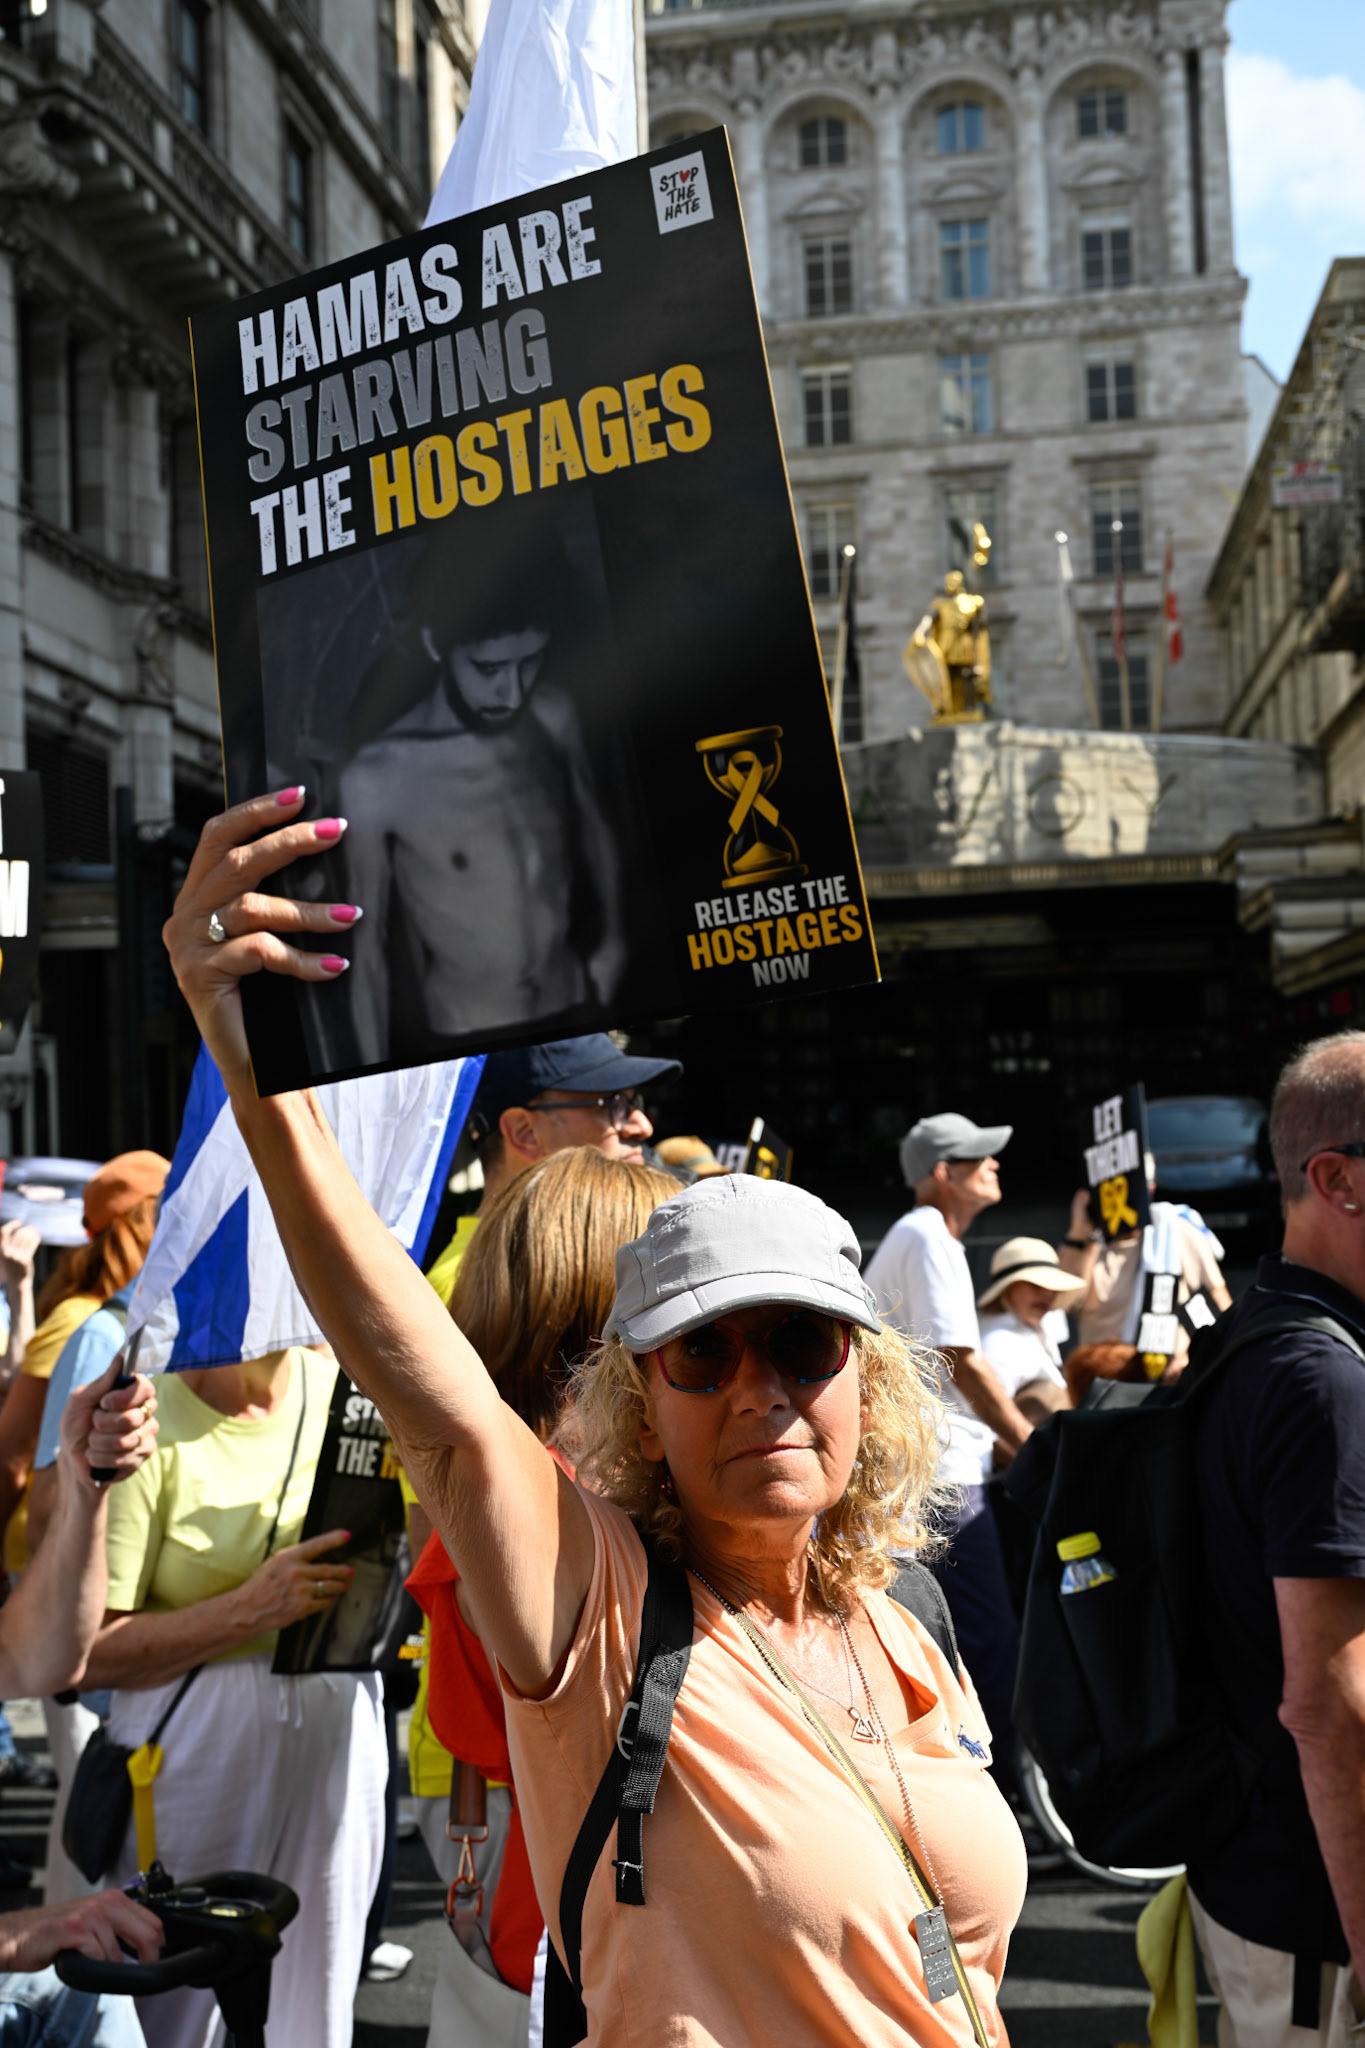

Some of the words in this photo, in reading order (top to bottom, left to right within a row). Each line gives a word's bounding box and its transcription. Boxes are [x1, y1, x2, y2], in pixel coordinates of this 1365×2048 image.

[665, 198, 701, 221] HATE
[666, 184, 696, 204] THE
[238, 243, 463, 396] HAMAS
[482, 195, 602, 310] ARE
[245, 308, 553, 483] STARVING
[250, 465, 357, 577] THE
[369, 363, 713, 536] HOSTAGES
[694, 884, 799, 930] RELEASE
[801, 875, 850, 909] THE
[686, 904, 863, 971] HOSTAGES
[752, 952, 811, 988] NOW
[1093, 1095, 1123, 1142] LET
[335, 1435, 381, 1479] THE
